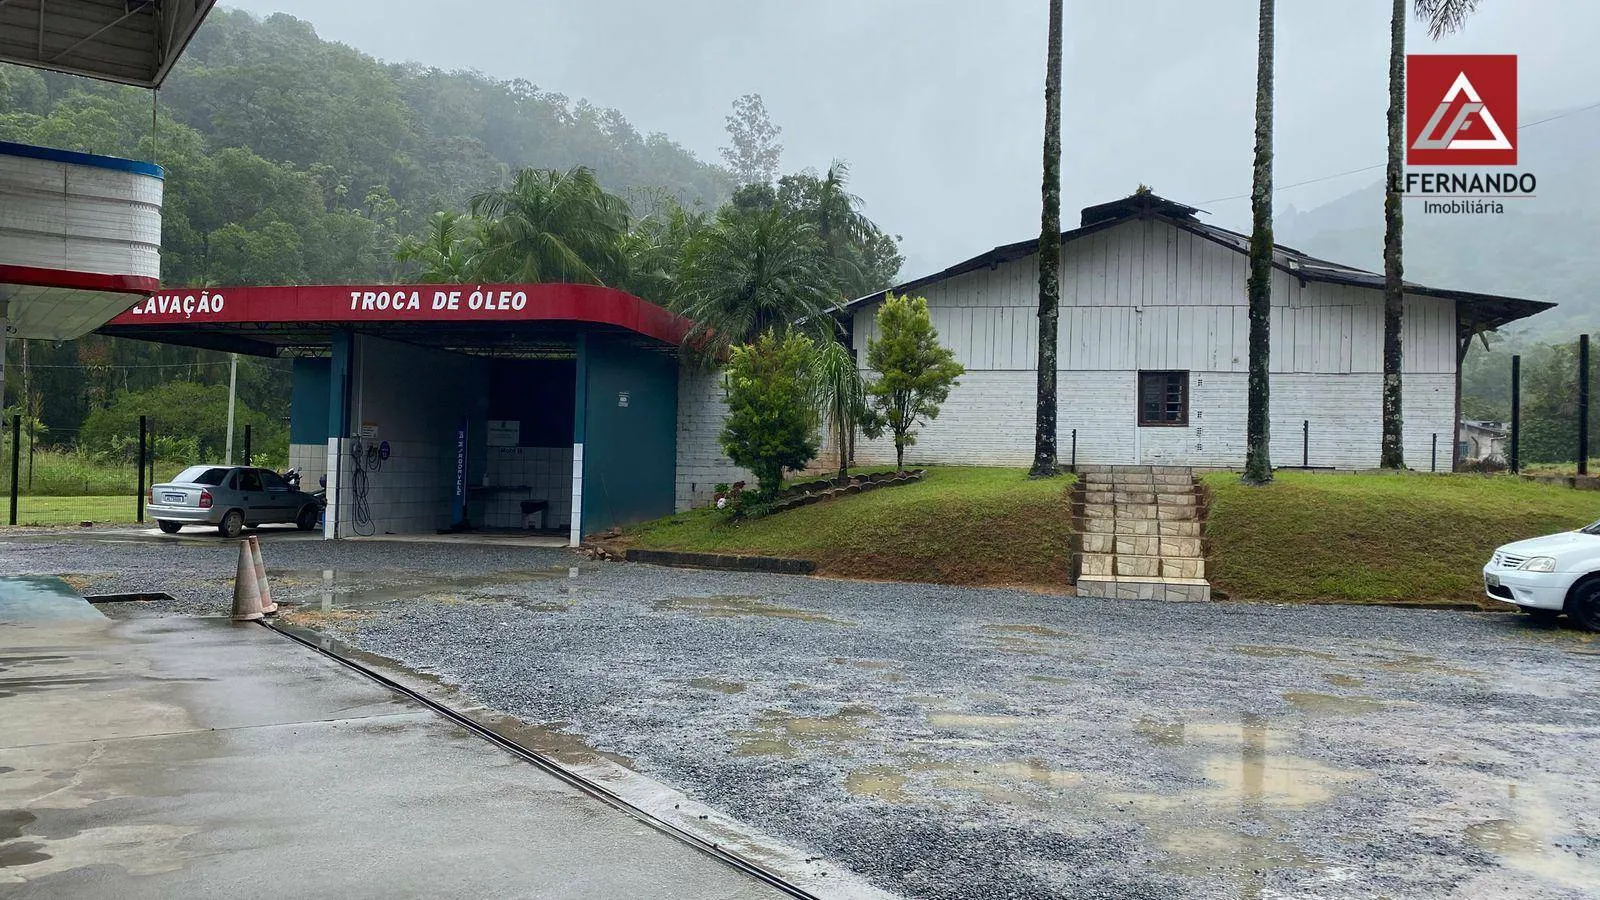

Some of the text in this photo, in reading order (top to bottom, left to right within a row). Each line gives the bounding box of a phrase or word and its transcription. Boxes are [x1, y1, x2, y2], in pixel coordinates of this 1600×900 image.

[350, 286, 527, 311] TROCA DE ÓLEO
